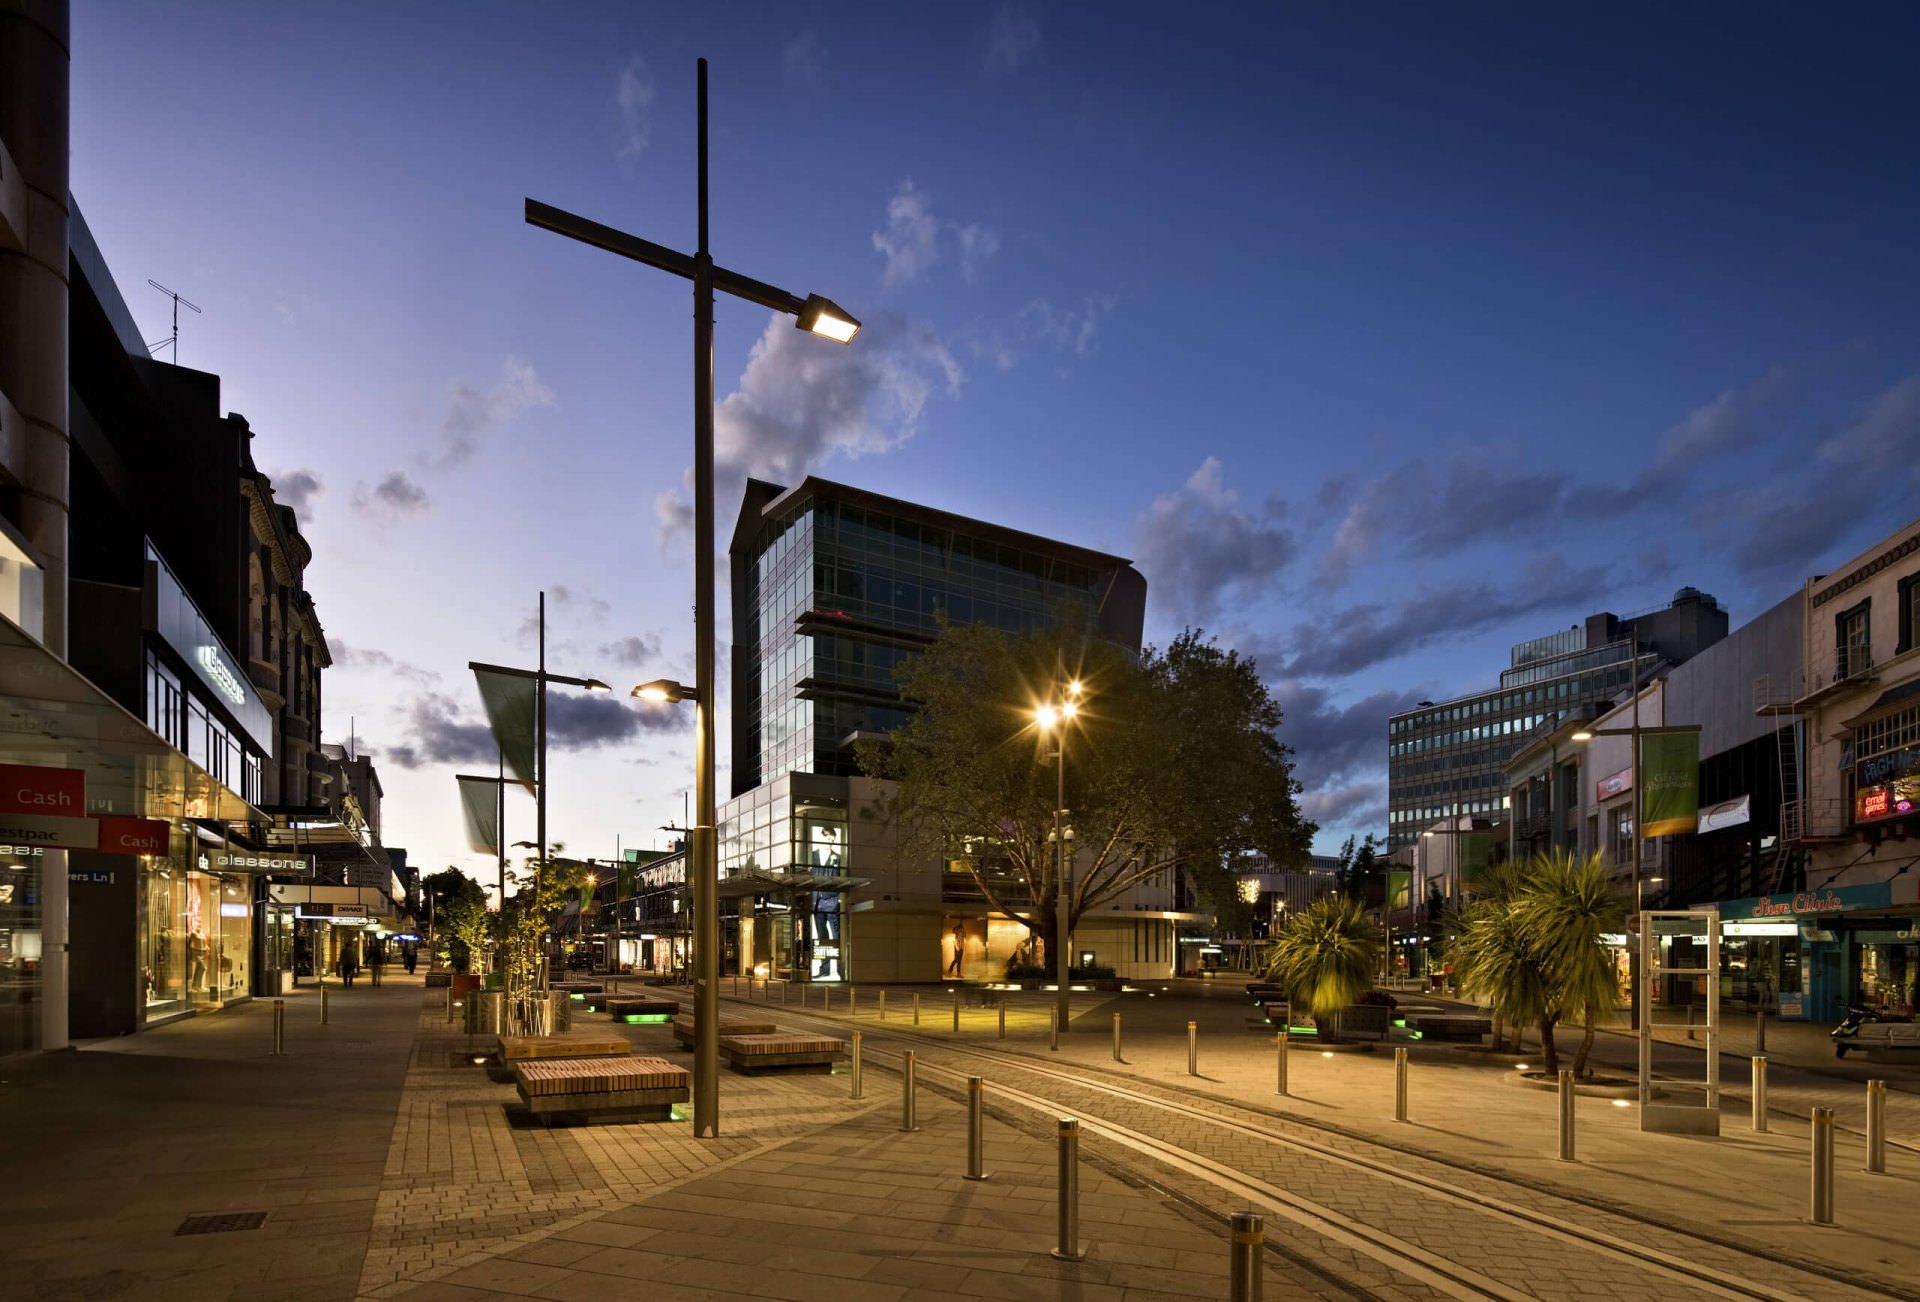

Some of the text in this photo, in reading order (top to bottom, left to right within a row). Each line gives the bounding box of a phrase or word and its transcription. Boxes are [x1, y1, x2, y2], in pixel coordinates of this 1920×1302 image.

[17, 788, 70, 807] Cash
[119, 834, 159, 849] Cash
[1752, 890, 1842, 918] Shoe Clinic
